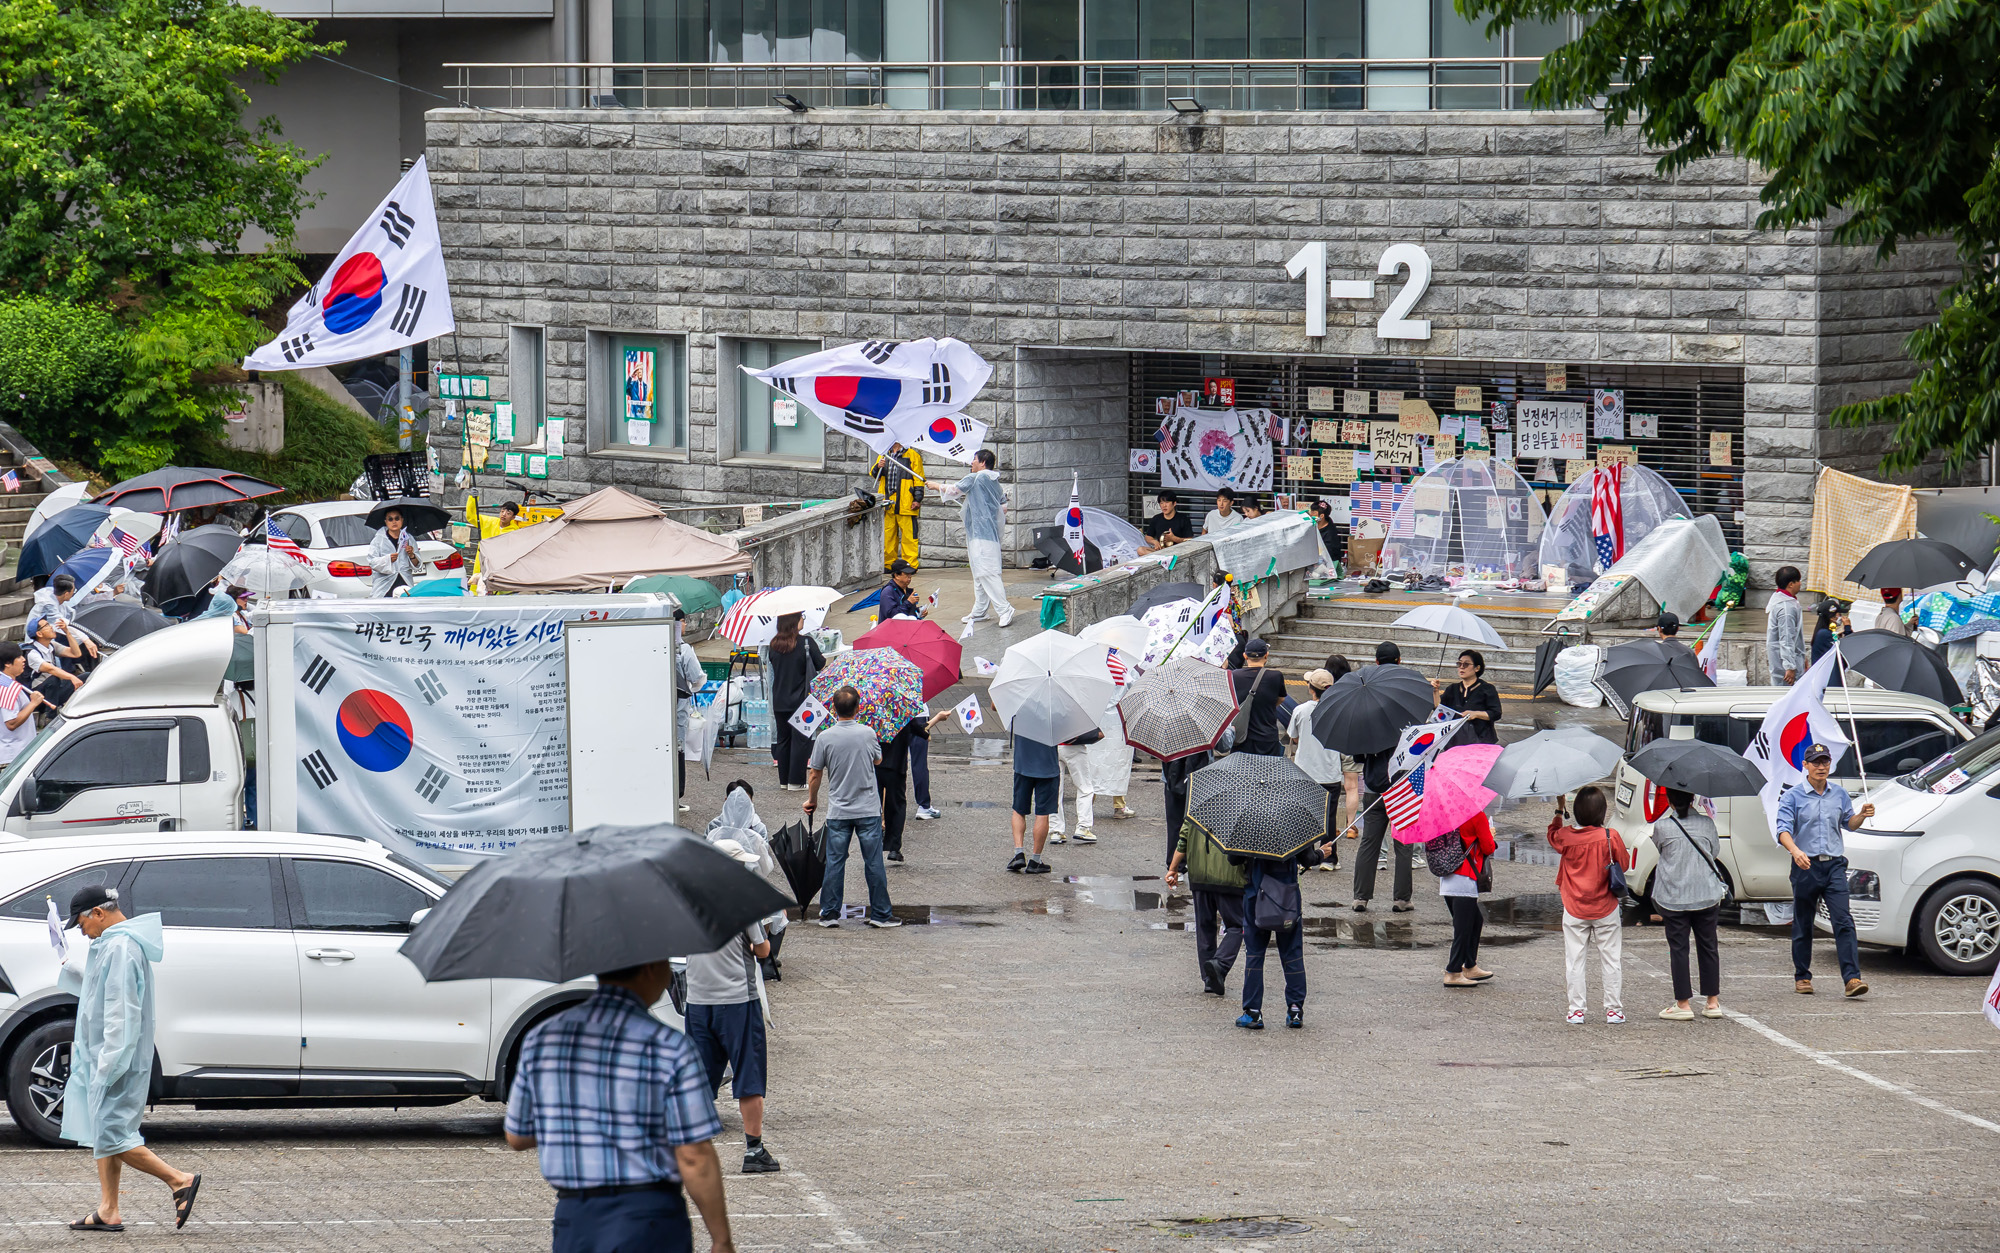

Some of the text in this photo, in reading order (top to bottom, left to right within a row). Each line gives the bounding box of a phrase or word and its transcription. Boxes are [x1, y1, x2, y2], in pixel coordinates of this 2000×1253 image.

[1285, 242, 1432, 339] 1-2
[1521, 407, 1558, 429] 부정선거
[1375, 450, 1412, 464] 재선거
[355, 621, 437, 652] 대한민국
[443, 624, 520, 651] 깨어있는
[386, 655, 403, 664] 시민의
[404, 657, 416, 665] 작은
[416, 829, 437, 838] 관심이
[438, 829, 459, 838] 세상을
[486, 828, 506, 837] 우리의
[507, 827, 528, 836] 참여가
[528, 826, 549, 835] 역사를
[480, 841, 495, 851] 우리
[499, 840, 516, 850] 함께
